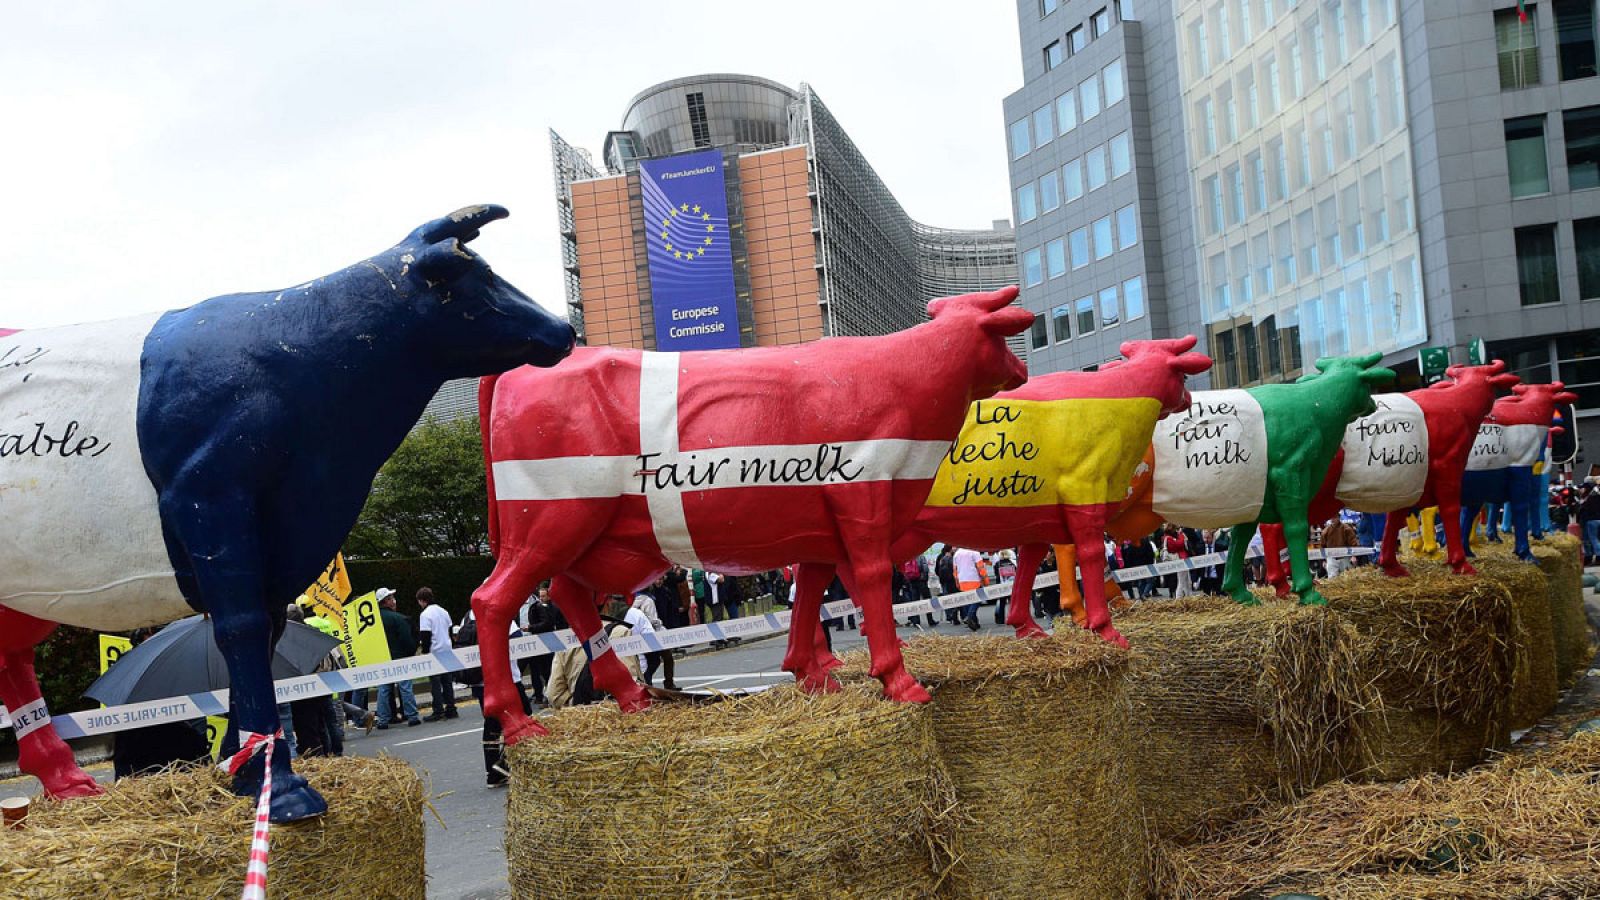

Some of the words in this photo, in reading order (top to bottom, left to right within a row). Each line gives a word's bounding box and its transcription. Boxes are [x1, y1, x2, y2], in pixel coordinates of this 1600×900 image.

[661, 165, 716, 180] #TeamJunckerEU
[671, 305, 720, 321] Europese
[669, 321, 725, 338] Commissie
[976, 400, 1022, 425] La
[0, 420, 112, 458] able
[949, 431, 1040, 465] leche
[1168, 417, 1229, 450] fair
[633, 452, 730, 493] Fair
[739, 443, 865, 483] mælk
[1186, 440, 1252, 469] milk
[1368, 444, 1425, 467] Milch
[951, 469, 1046, 505] justa
[358, 600, 376, 635] CR
